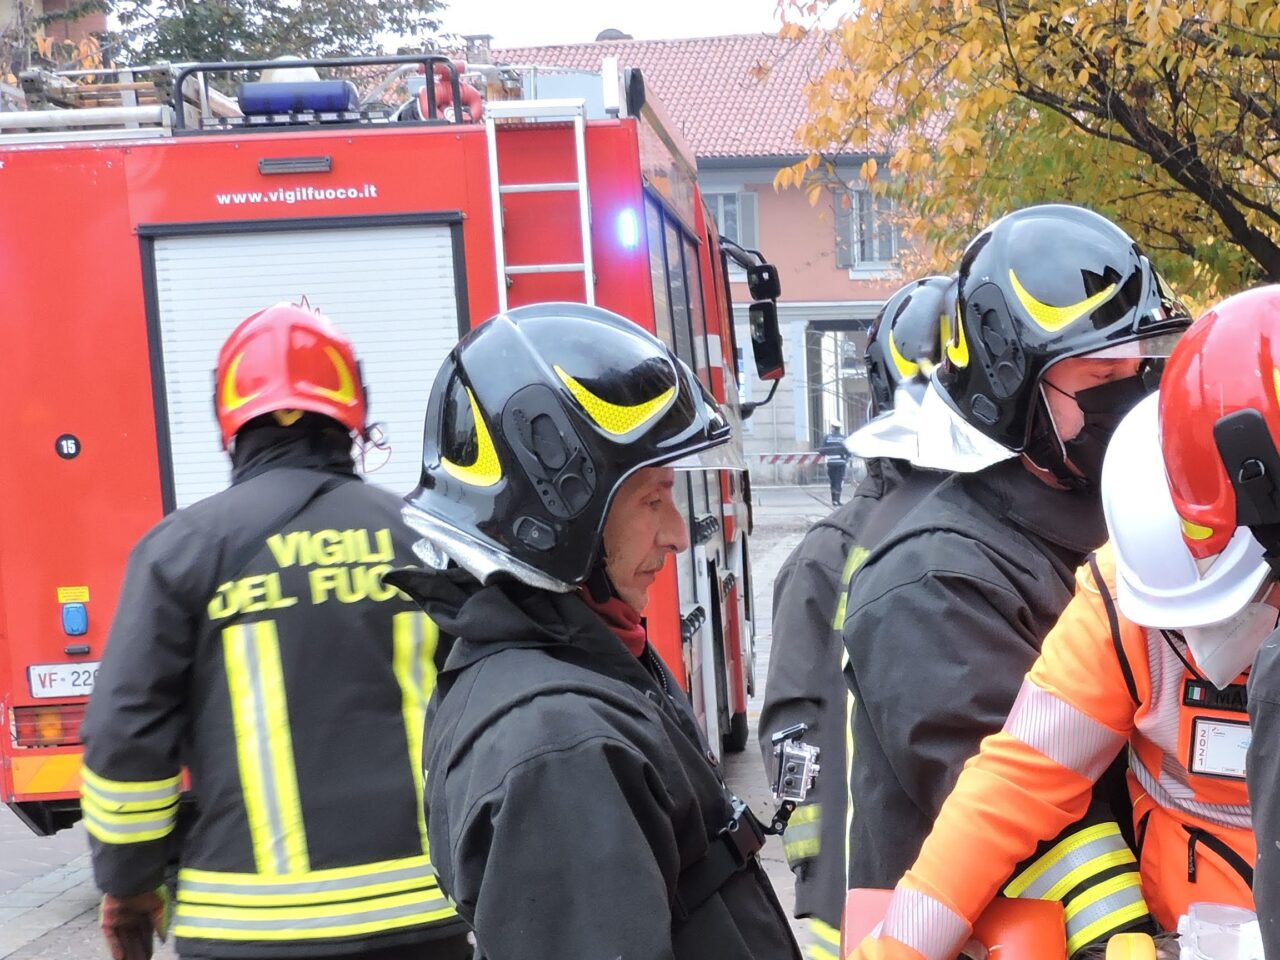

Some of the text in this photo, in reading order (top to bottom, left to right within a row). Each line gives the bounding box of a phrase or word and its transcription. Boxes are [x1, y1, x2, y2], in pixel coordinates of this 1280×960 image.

[216, 184, 378, 204] www.vigilfuoco.it
[61, 440, 76, 454] 15
[265, 528, 395, 568] VIGILI
[207, 571, 298, 620] DEL
[38, 669, 99, 689] VF 22
[1198, 729, 1207, 766] 2021
